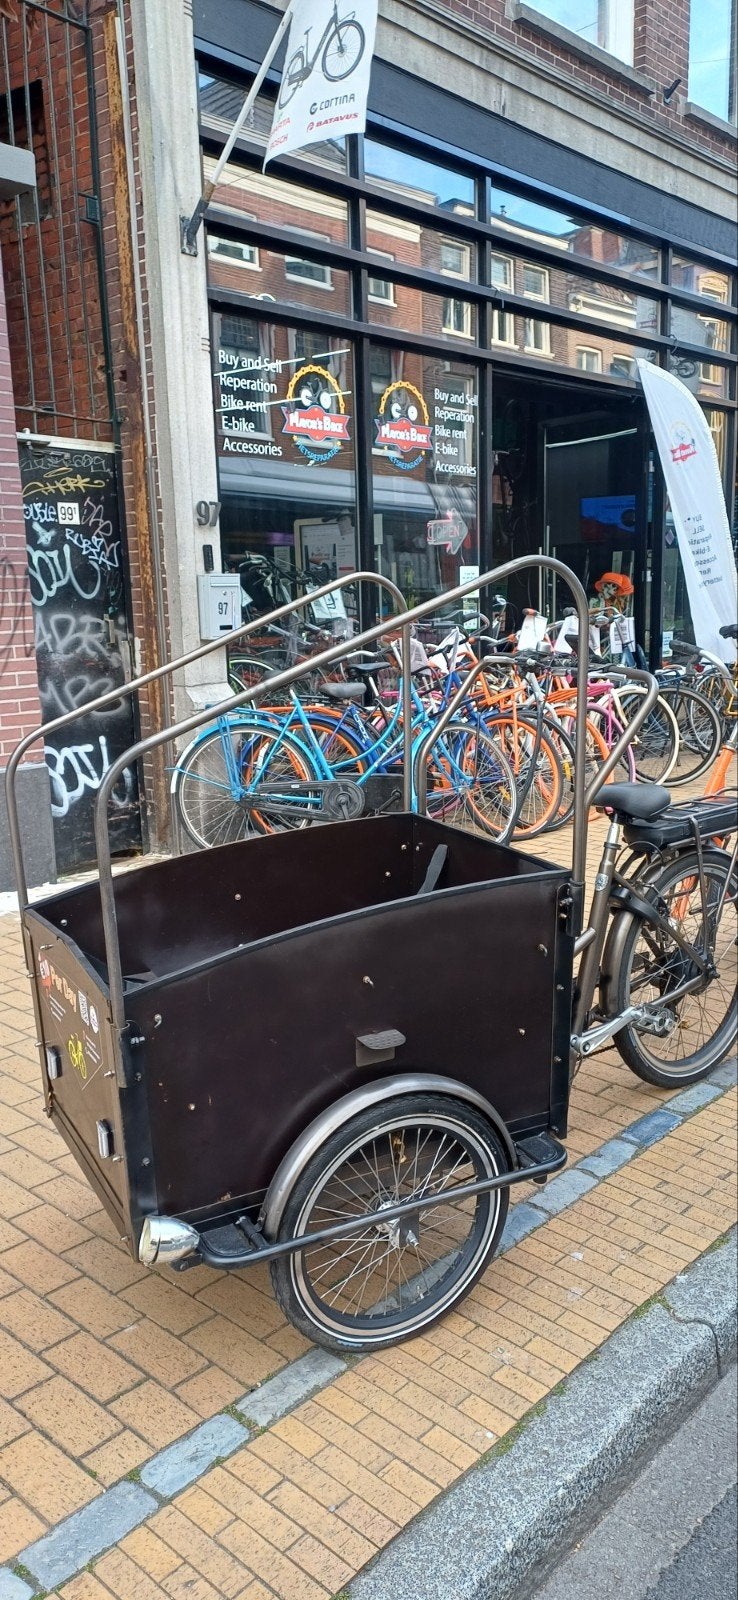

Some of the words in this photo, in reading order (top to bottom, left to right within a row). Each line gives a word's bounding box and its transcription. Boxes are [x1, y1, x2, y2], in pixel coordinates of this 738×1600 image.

[316, 112, 359, 128] BATAVUS
[218, 349, 239, 370] Buy
[241, 355, 261, 370] and
[263, 358, 283, 374] Sell
[219, 372, 278, 394] Reperation
[220, 393, 244, 409] Bike
[245, 400, 268, 414] rent
[433, 387, 449, 404] Buy
[450, 392, 465, 404] and
[465, 394, 479, 407] Sell
[221, 415, 256, 433] E-bike
[434, 406, 475, 424] Reperation
[434, 424, 451, 438] Bike
[451, 429, 467, 440] rent
[222, 437, 283, 457] Accessories
[435, 442, 459, 456] E-bike
[434, 460, 477, 475] Accessories
[196, 500, 222, 527] 97
[218, 602, 228, 615] 97
